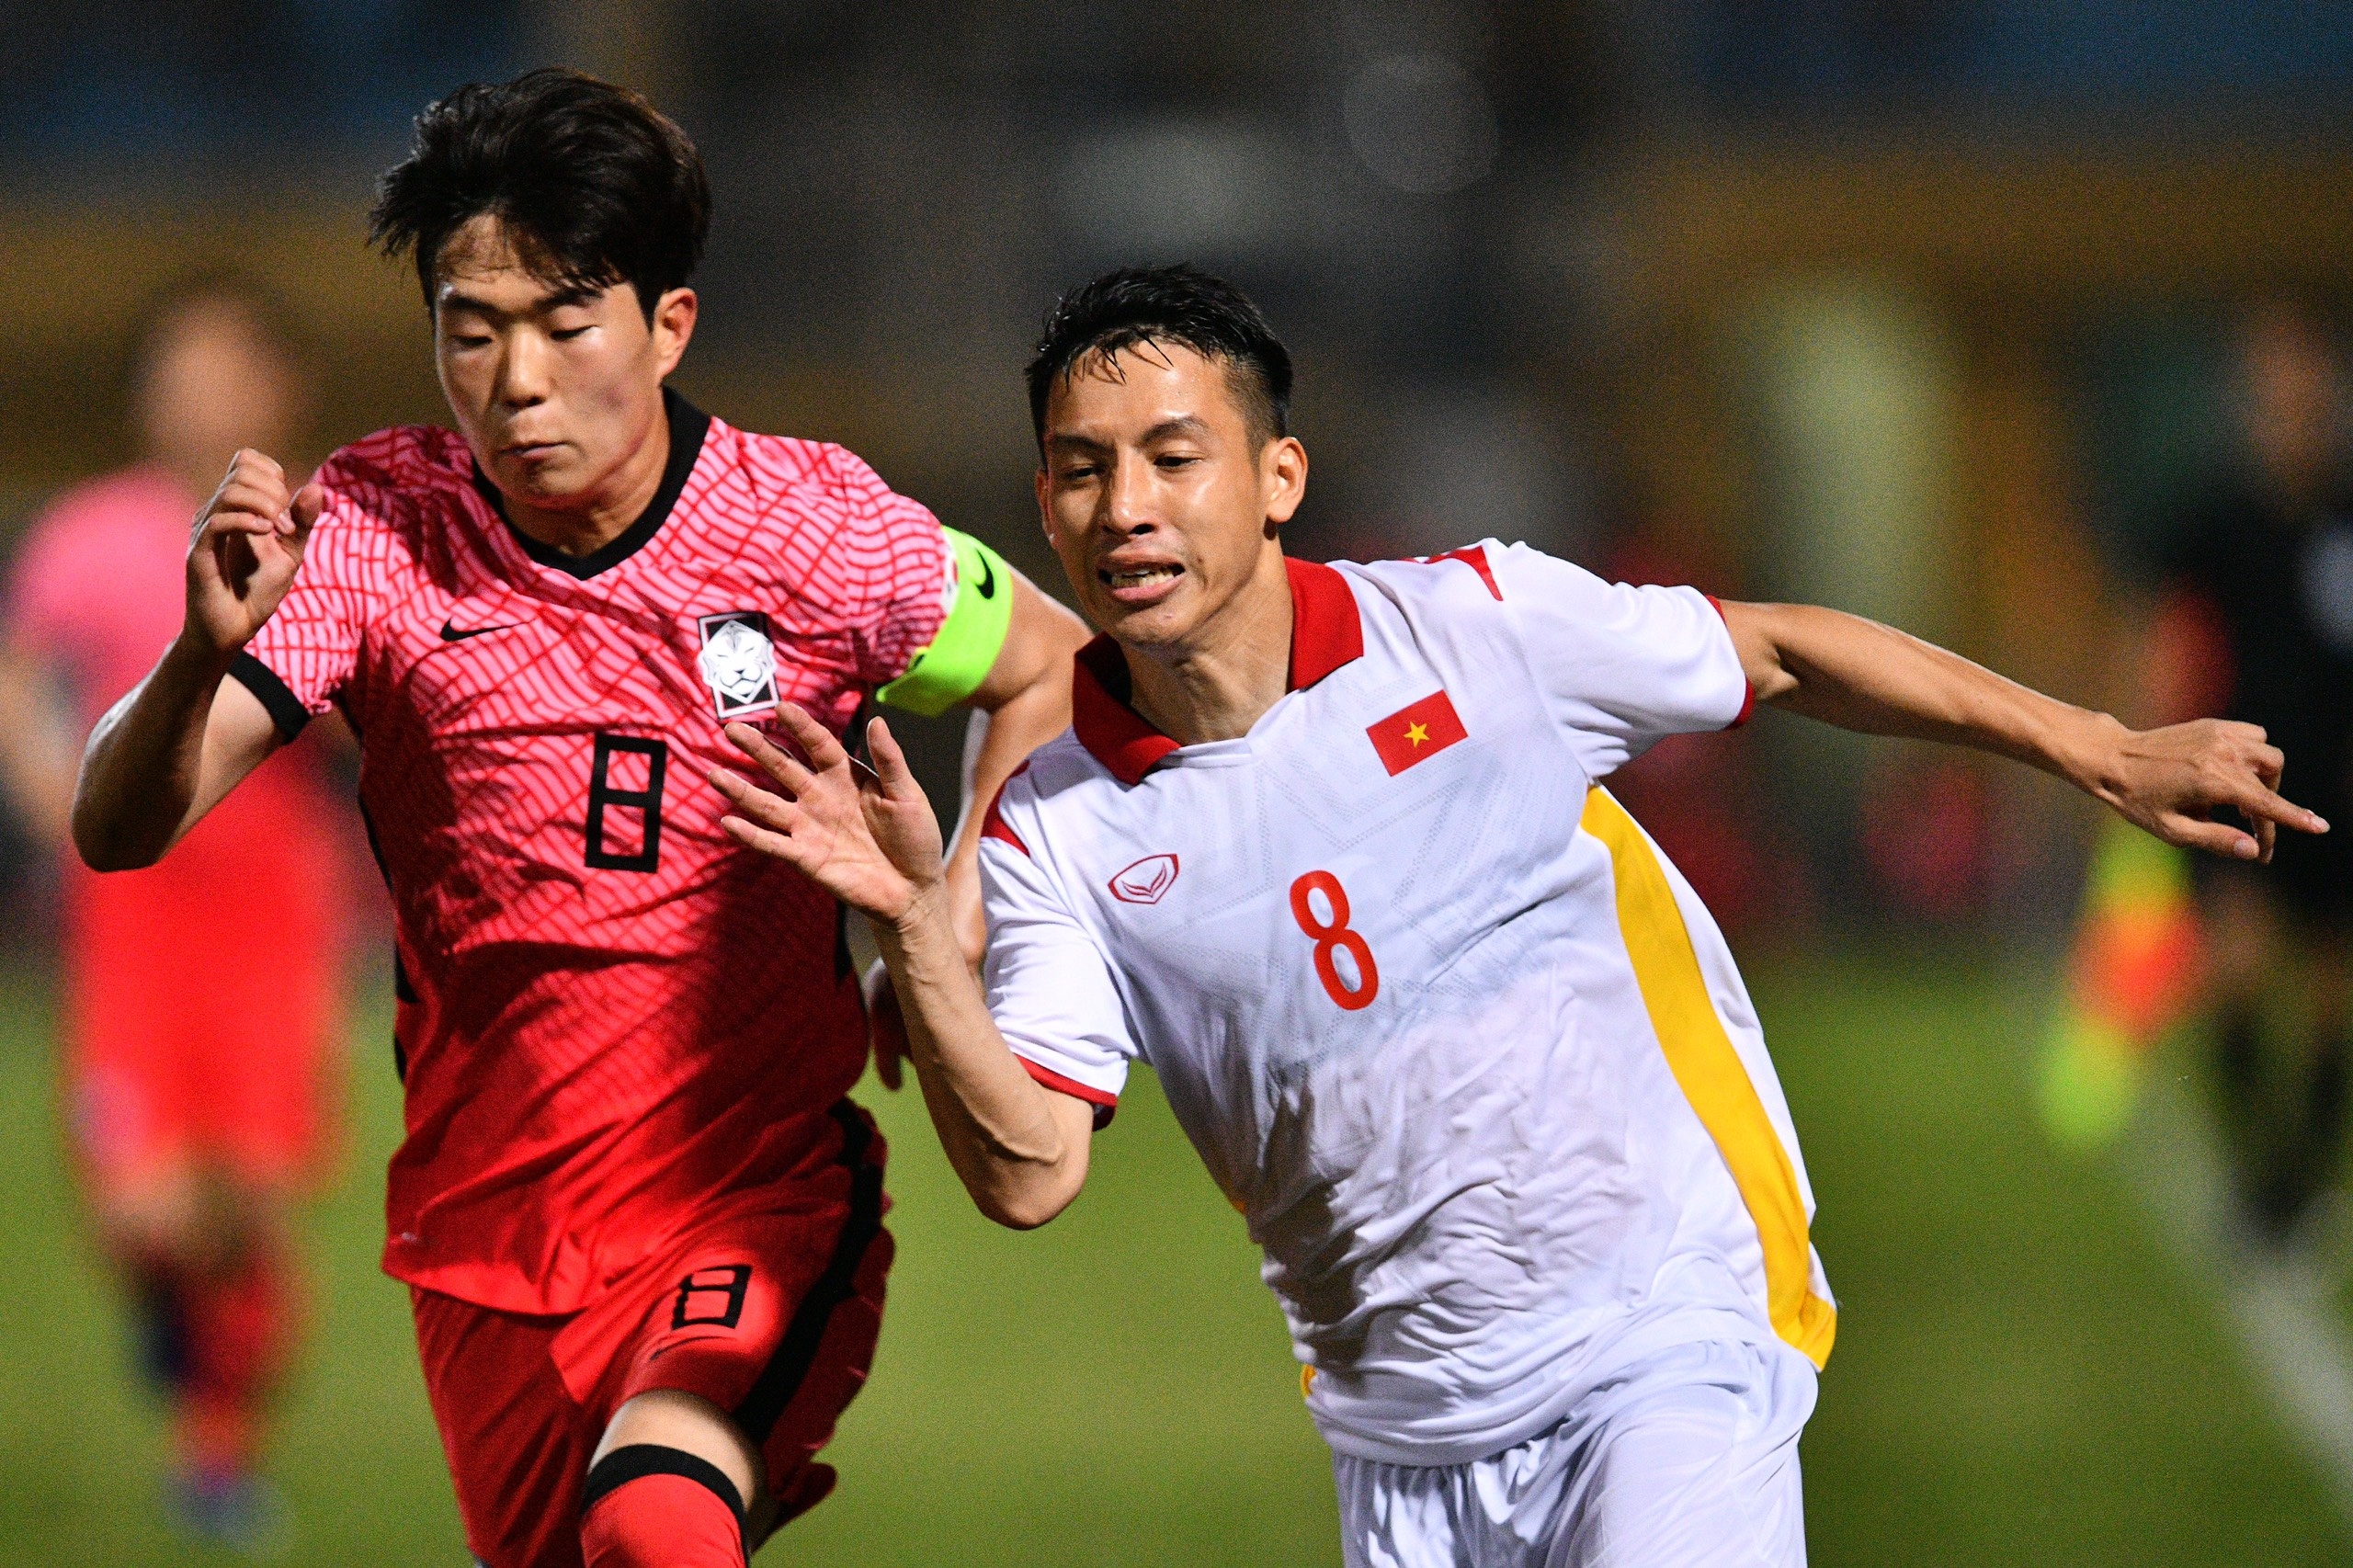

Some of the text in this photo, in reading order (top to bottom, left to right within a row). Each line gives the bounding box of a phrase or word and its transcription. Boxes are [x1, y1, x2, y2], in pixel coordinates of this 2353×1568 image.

[585, 731, 667, 874] 8
[1290, 869, 1380, 1011] 8
[671, 1264, 753, 1331] 8
